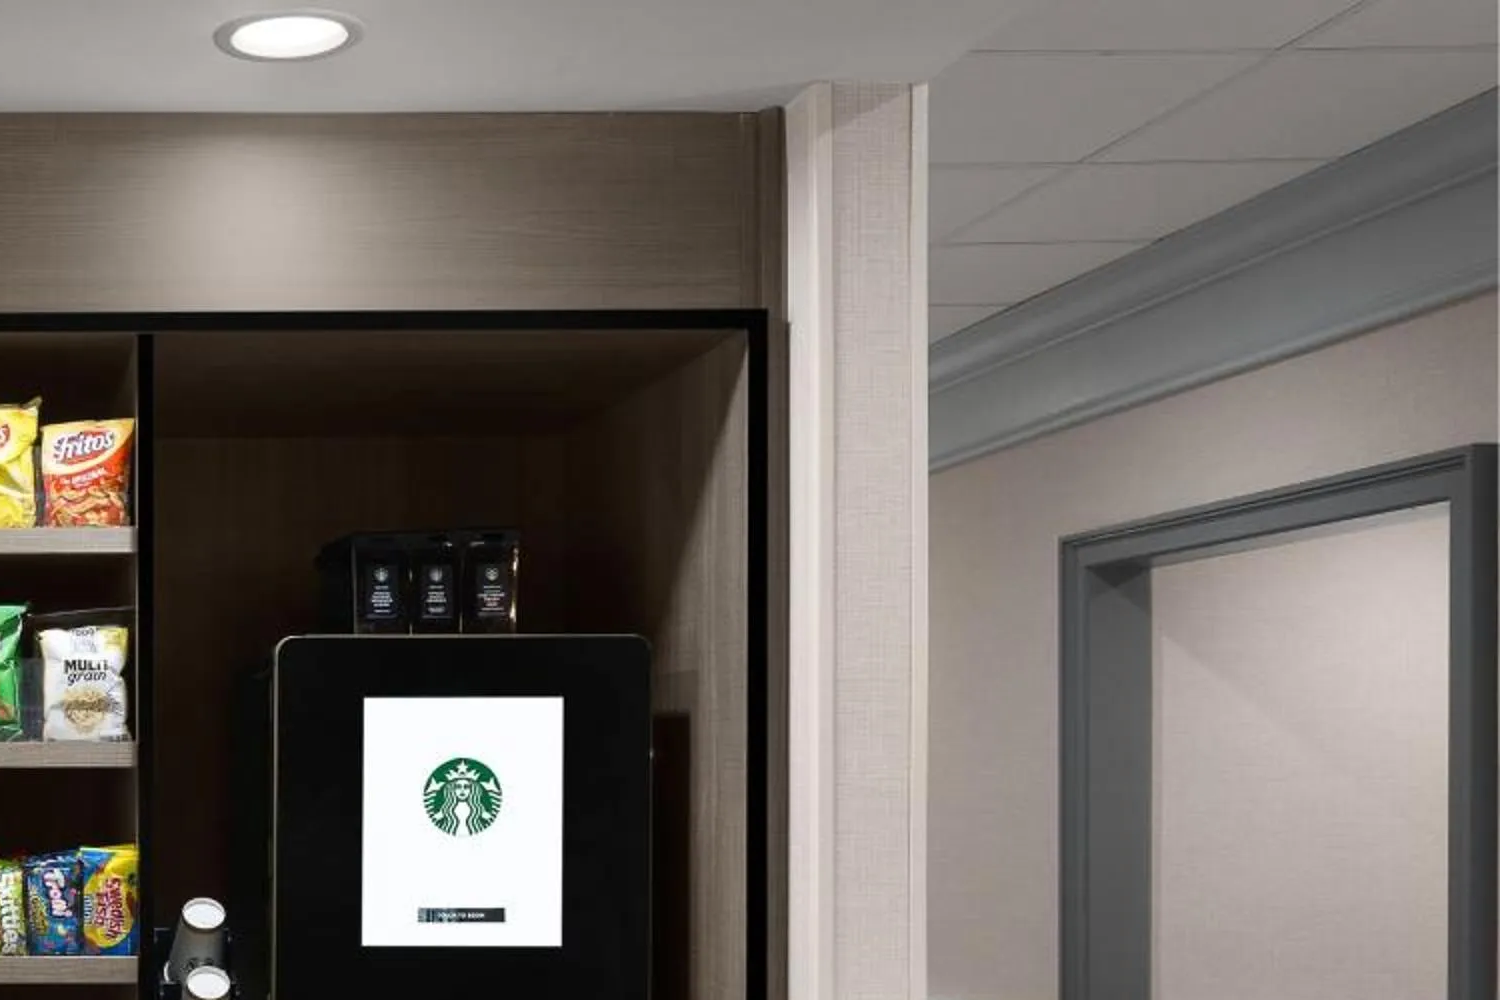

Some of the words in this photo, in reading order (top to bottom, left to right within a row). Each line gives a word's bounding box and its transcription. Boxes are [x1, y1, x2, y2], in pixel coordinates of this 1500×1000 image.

[52, 430, 115, 464] Fritos
[63, 659, 109, 675] MULTI
[67, 671, 108, 687] grain
[43, 867, 73, 918] Trolli
[94, 892, 110, 927] Fish
[105, 876, 126, 940] Swedish
